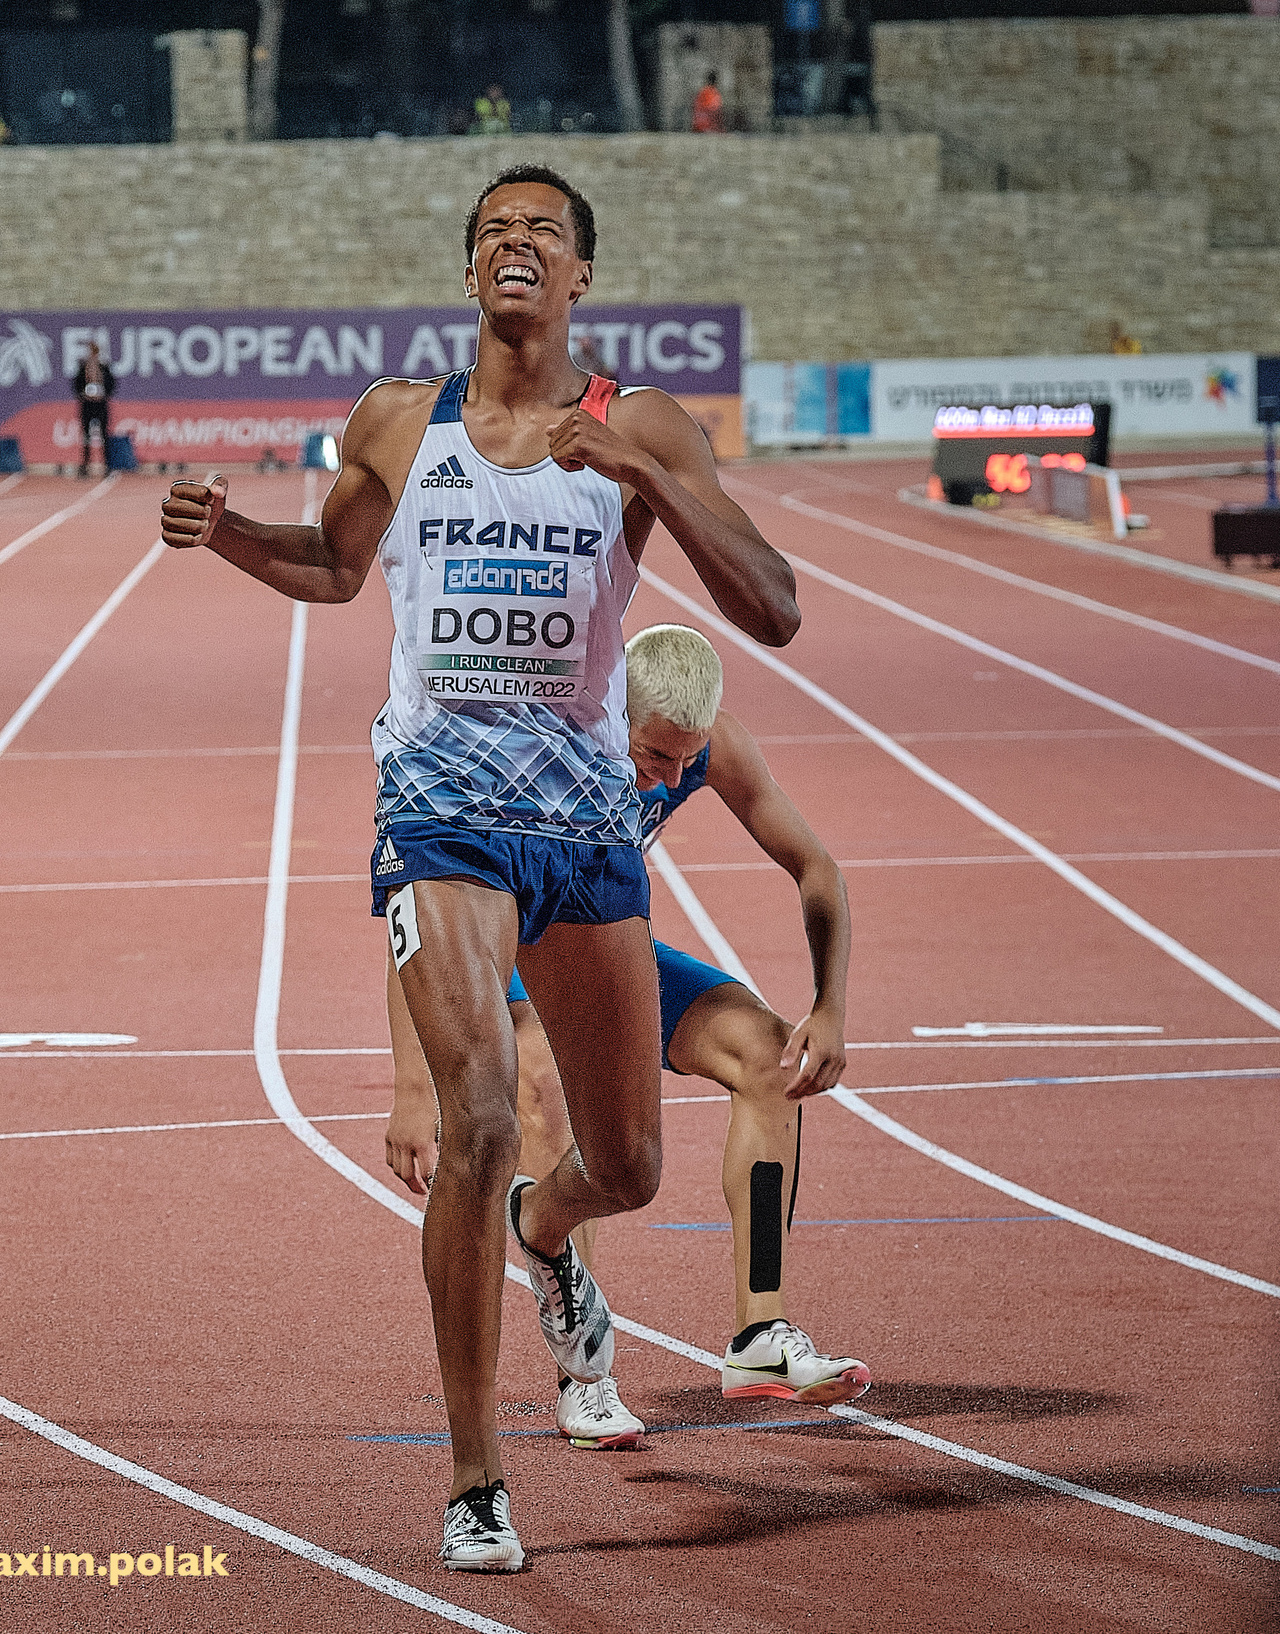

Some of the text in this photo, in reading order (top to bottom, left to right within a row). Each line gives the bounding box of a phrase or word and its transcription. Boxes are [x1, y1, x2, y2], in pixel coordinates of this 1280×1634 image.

[61, 321, 726, 377] EUROPEAN ATTICS
[420, 474, 474, 490] adidas
[419, 518, 602, 558] FRANCE
[430, 607, 576, 649] DOBO
[450, 655, 455, 668] I
[459, 656, 492, 669] RUN
[427, 676, 575, 698] JERUSALEM 2022
[375, 859, 405, 876] adidas
[391, 903, 408, 960] 5
